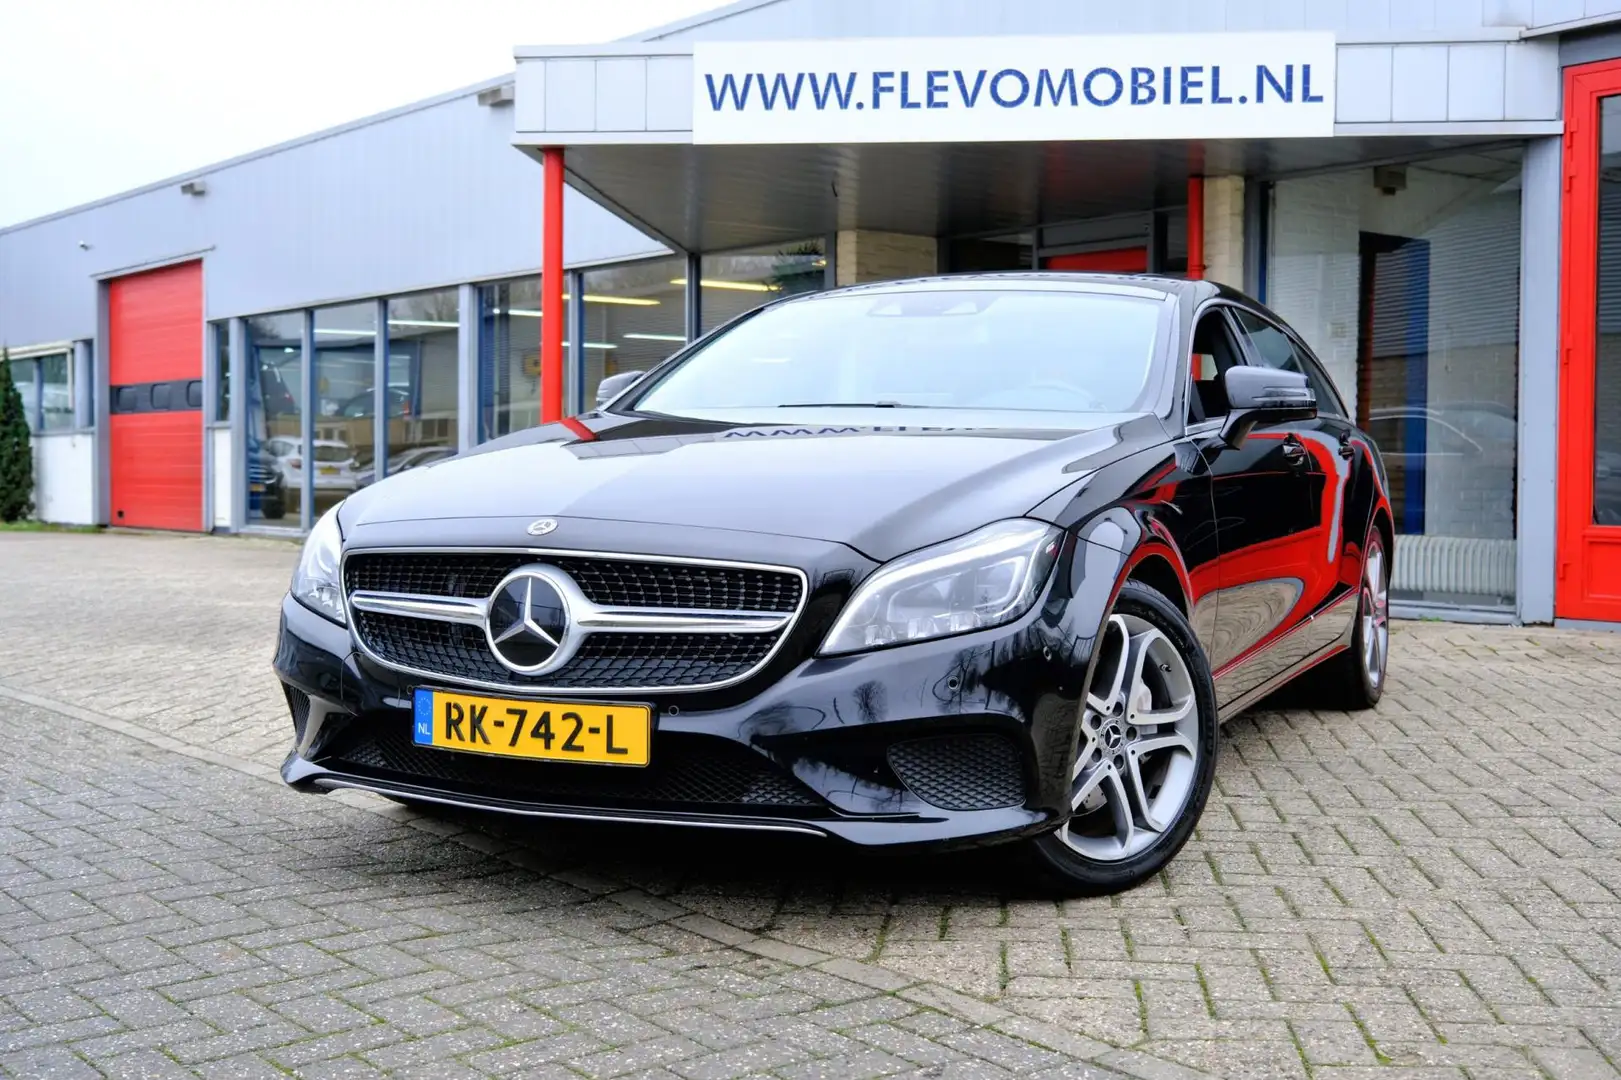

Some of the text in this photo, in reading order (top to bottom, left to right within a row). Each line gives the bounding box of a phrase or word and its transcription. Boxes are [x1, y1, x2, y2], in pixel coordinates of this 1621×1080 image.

[704, 64, 1324, 111] WWW.FLEVOMOBIEL.NL
[418, 722, 430, 735] NL
[445, 702, 628, 755] RK-742-L
